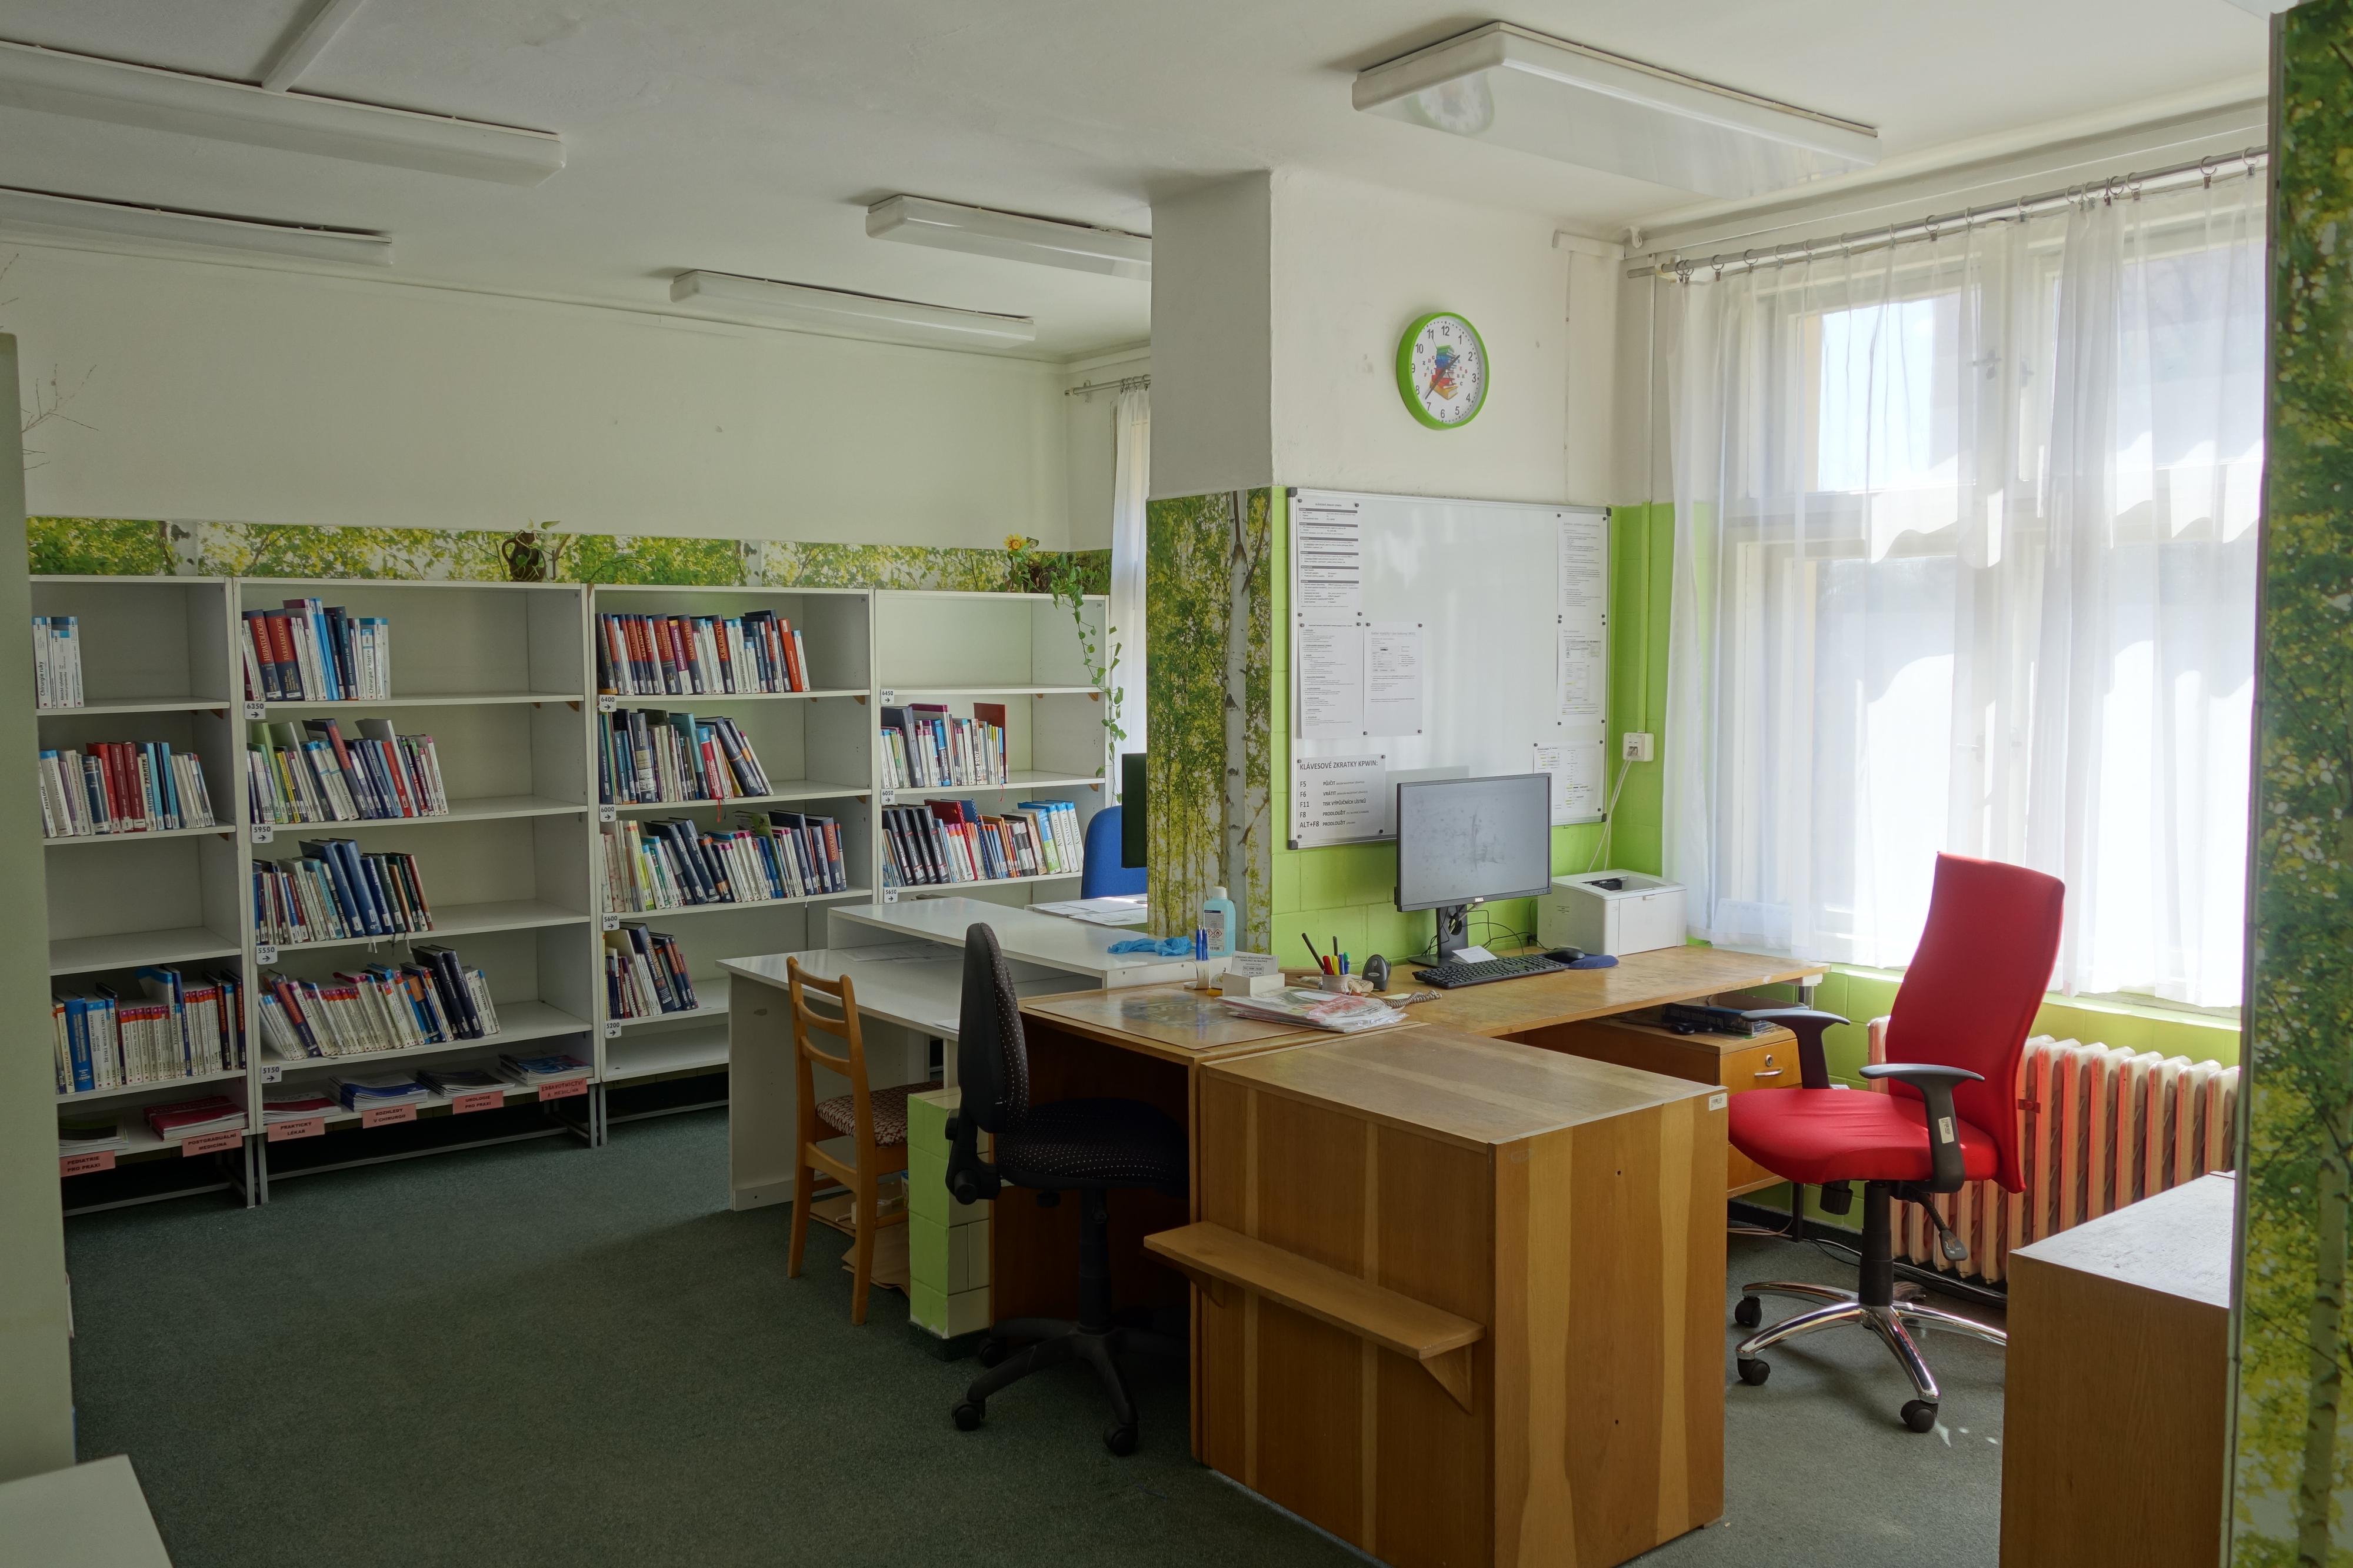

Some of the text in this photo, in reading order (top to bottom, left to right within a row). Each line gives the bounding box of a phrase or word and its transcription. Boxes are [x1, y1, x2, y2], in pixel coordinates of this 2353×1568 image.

[1427, 329, 1434, 339] 11
[1441, 325, 1449, 336] 12
[1458, 335, 1462, 345] 1
[1415, 343, 1424, 353] 10
[1468, 351, 1472, 361] 2
[1412, 363, 1415, 373] 9
[1472, 373, 1477, 383] 3
[1415, 385, 1420, 395] 8
[1466, 393, 1471, 402] 4
[1427, 402, 1431, 411] 7
[1455, 406, 1459, 415] 5
[1441, 409, 1445, 418] 6
[255, 618, 271, 661] HEPATOLOGIE
[275, 618, 289, 660] FARMAKOLOGIE
[636, 625, 646, 658] KOLOSKOPIE
[714, 624, 726, 659] PORODNICTVÍ
[687, 639, 695, 659] NEMOCI
[1299, 761, 1332, 770] KLÁVESOVÉ
[142, 759, 150, 785] ZKRATEK
[826, 825, 836, 860] SEXUOLOGIE
[296, 993, 311, 1019] PATOLOGIE
[280, 1121, 312, 1130] PRAKTICKÝ
[188, 1133, 236, 1145] POSTGRADUÁLNÍ
[198, 1142, 228, 1150] MEDICÍNA
[67, 1156, 100, 1165] PEDIATRIE
